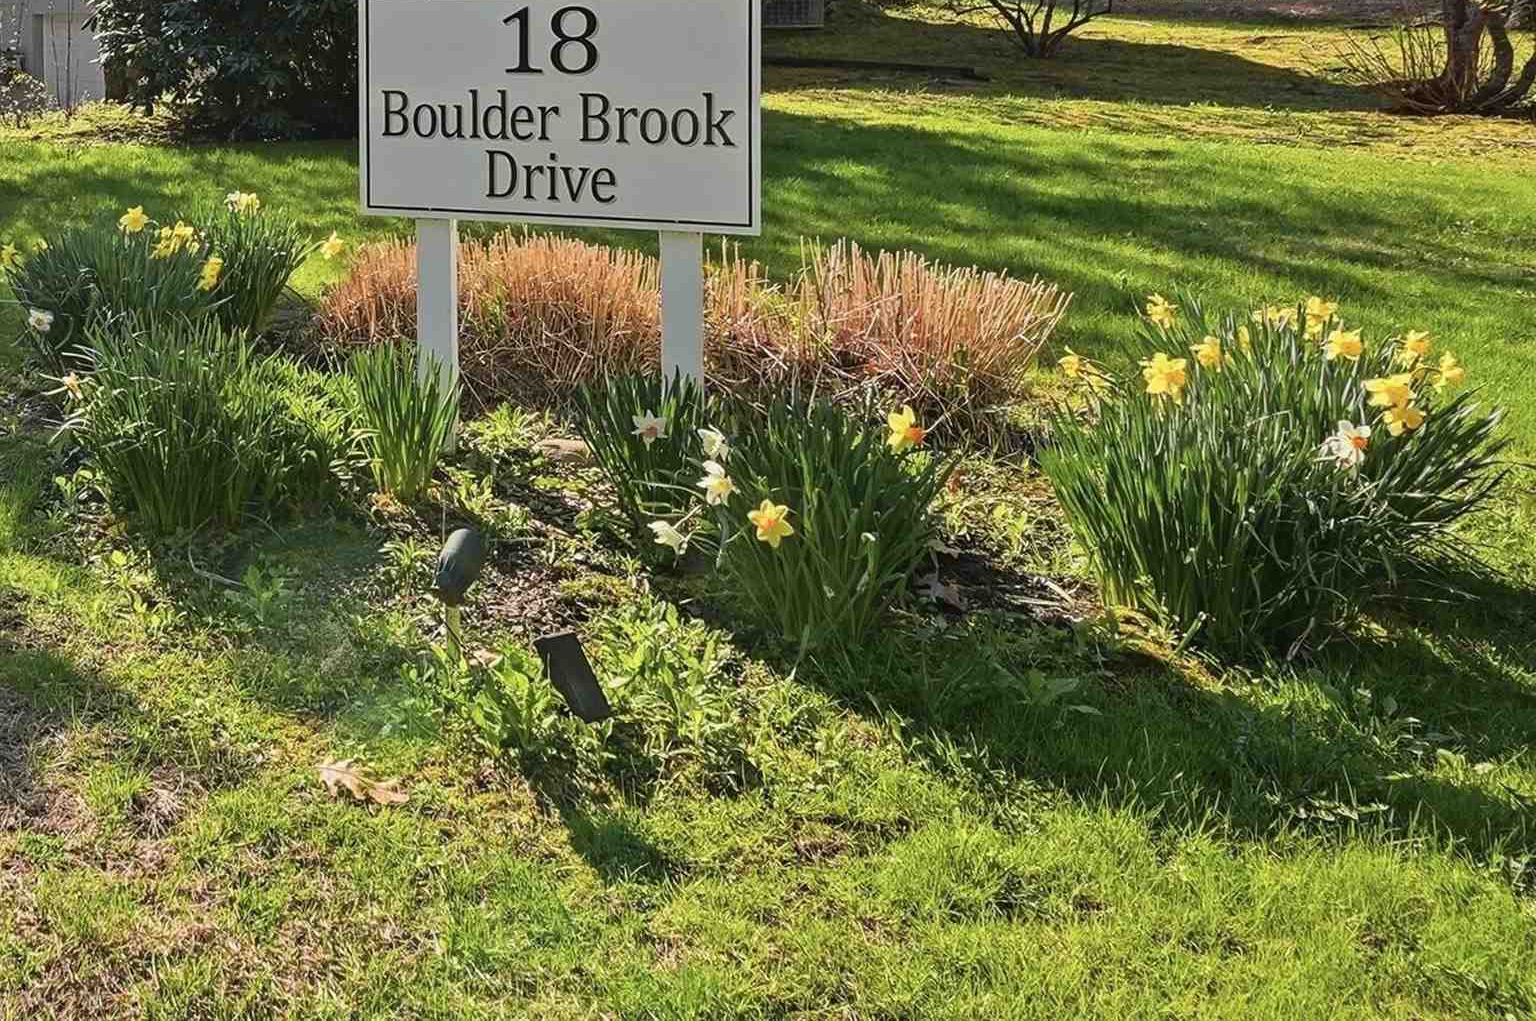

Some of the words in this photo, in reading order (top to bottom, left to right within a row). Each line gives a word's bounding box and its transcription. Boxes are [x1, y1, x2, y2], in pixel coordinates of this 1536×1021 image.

[502, 5, 600, 76] 18
[381, 88, 561, 143] Boulder
[578, 91, 737, 148] Brook
[484, 149, 618, 205] Drive
